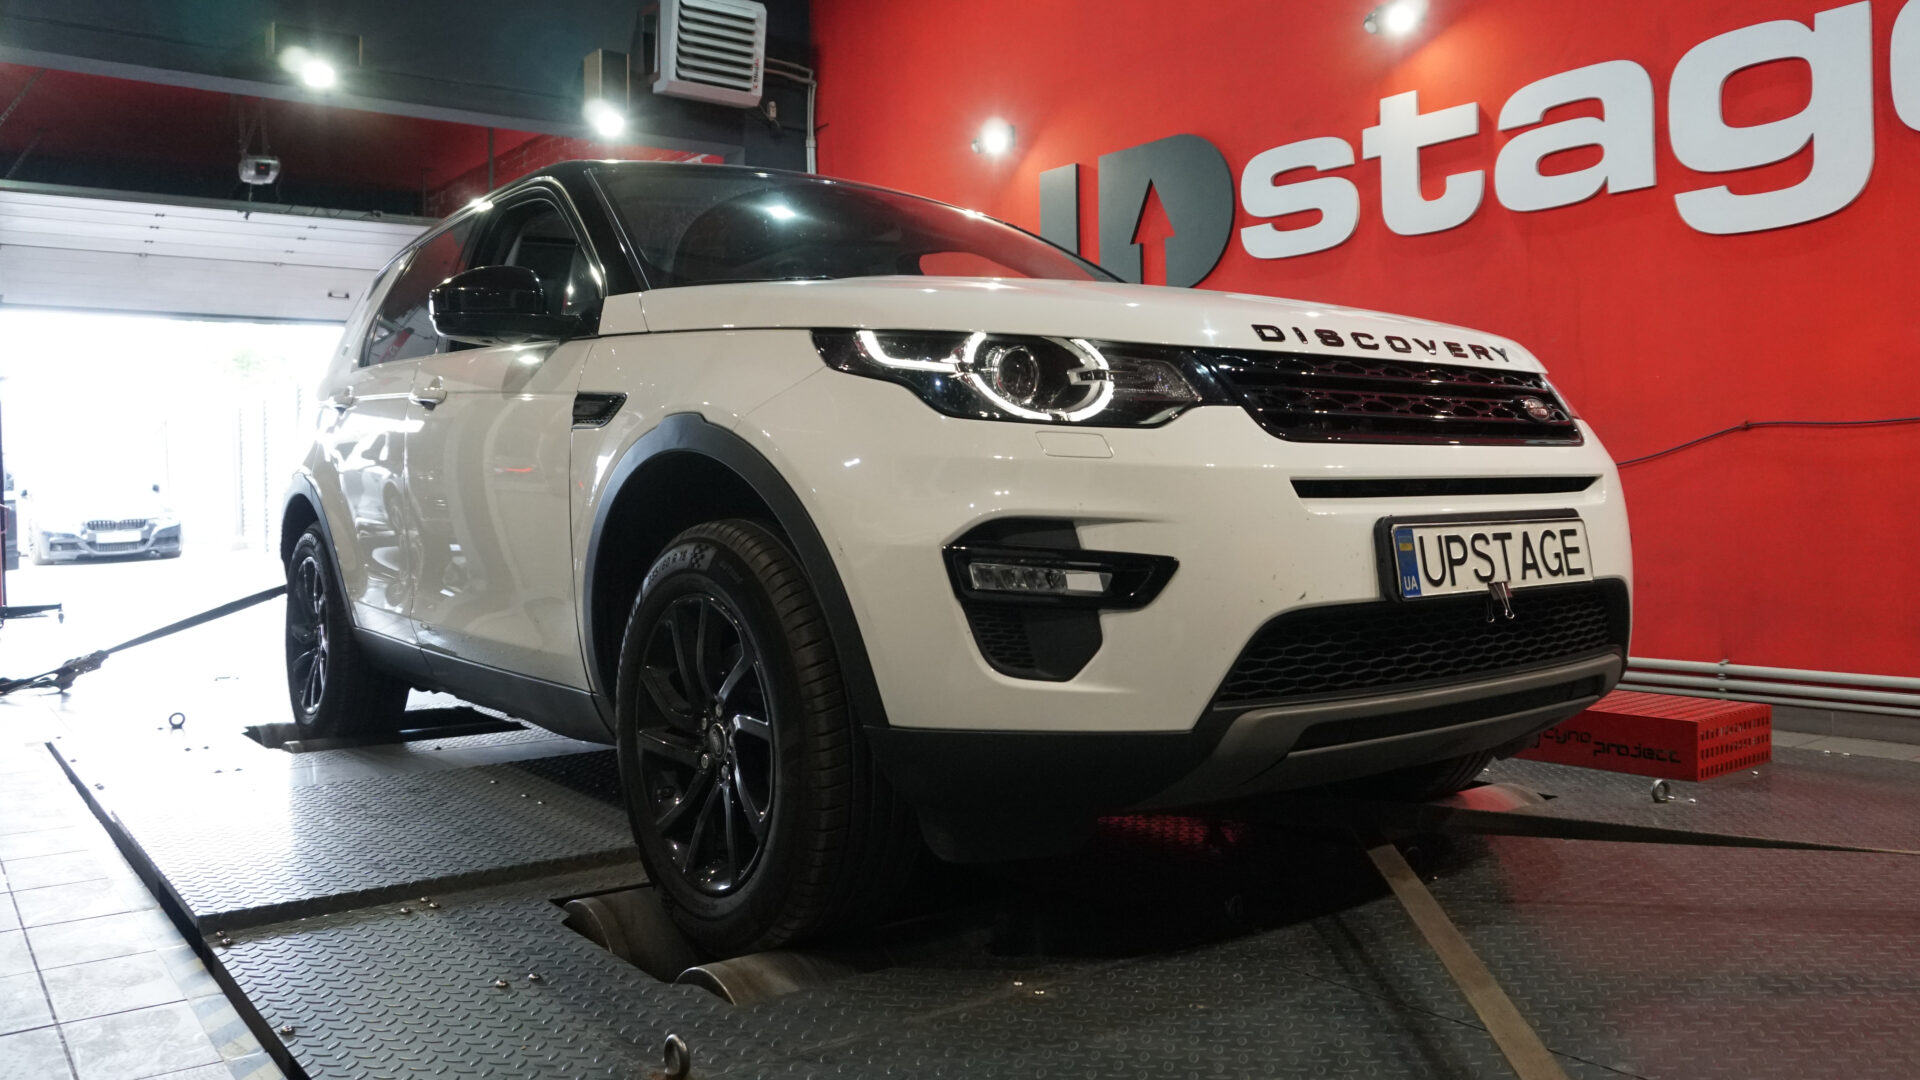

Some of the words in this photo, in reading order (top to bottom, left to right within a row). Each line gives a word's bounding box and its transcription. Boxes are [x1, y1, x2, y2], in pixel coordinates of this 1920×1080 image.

[1251, 323, 1511, 363] DISCOVERY
[1403, 575, 1419, 591] UA
[1418, 528, 1586, 588] UPSTAGE
